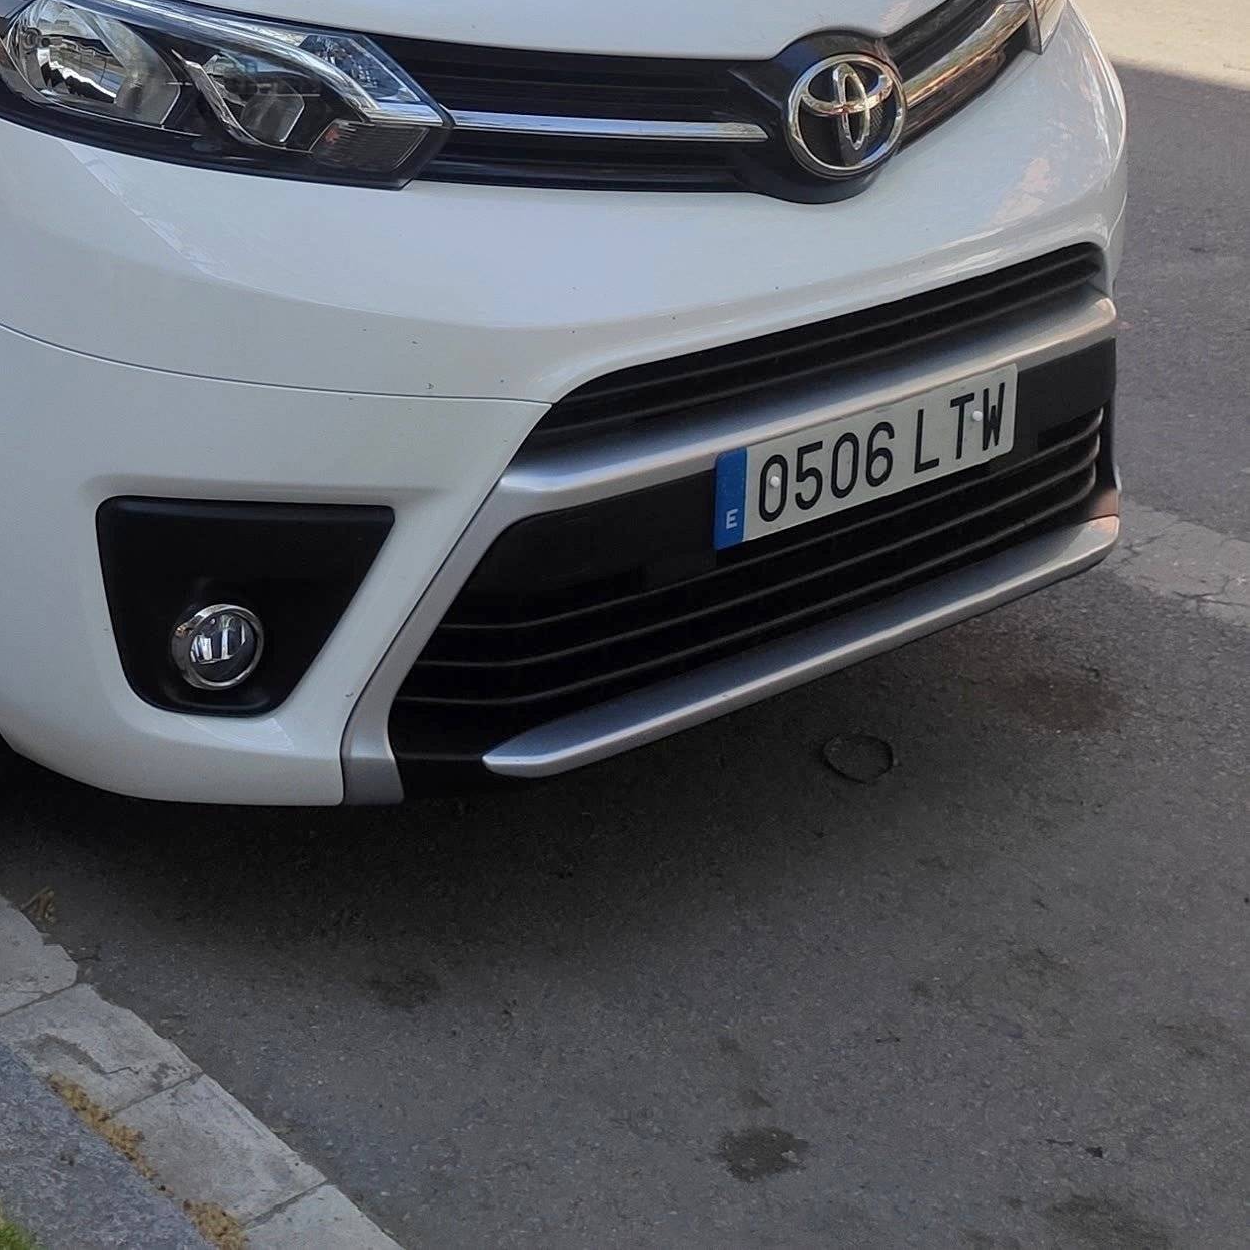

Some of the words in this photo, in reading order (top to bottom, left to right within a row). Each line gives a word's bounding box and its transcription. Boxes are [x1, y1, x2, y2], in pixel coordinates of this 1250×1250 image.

[758, 421, 896, 522] 0506
[914, 382, 1006, 474] LTW
[725, 508, 739, 529] E
